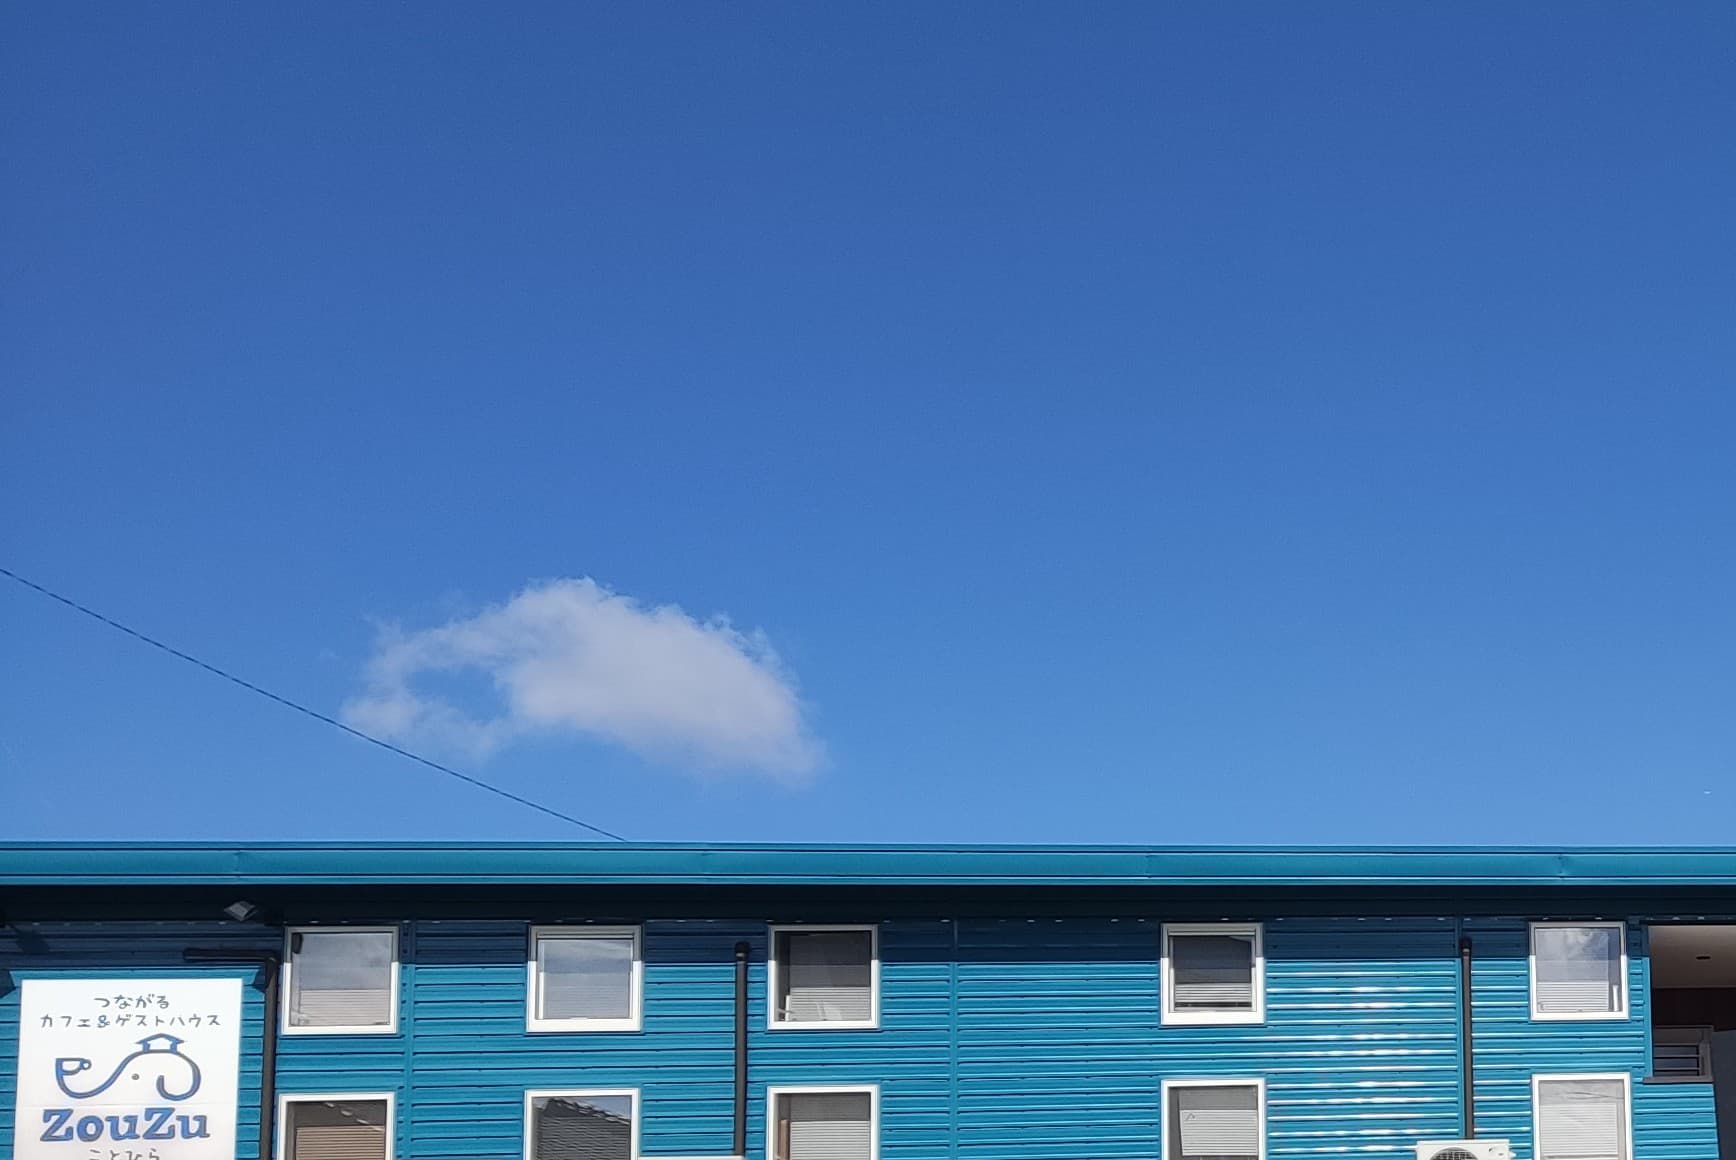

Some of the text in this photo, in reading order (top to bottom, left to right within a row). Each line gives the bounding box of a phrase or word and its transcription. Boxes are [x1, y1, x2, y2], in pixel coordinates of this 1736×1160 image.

[94, 993, 170, 1010] つながる
[40, 1107, 211, 1142] ZouZu
